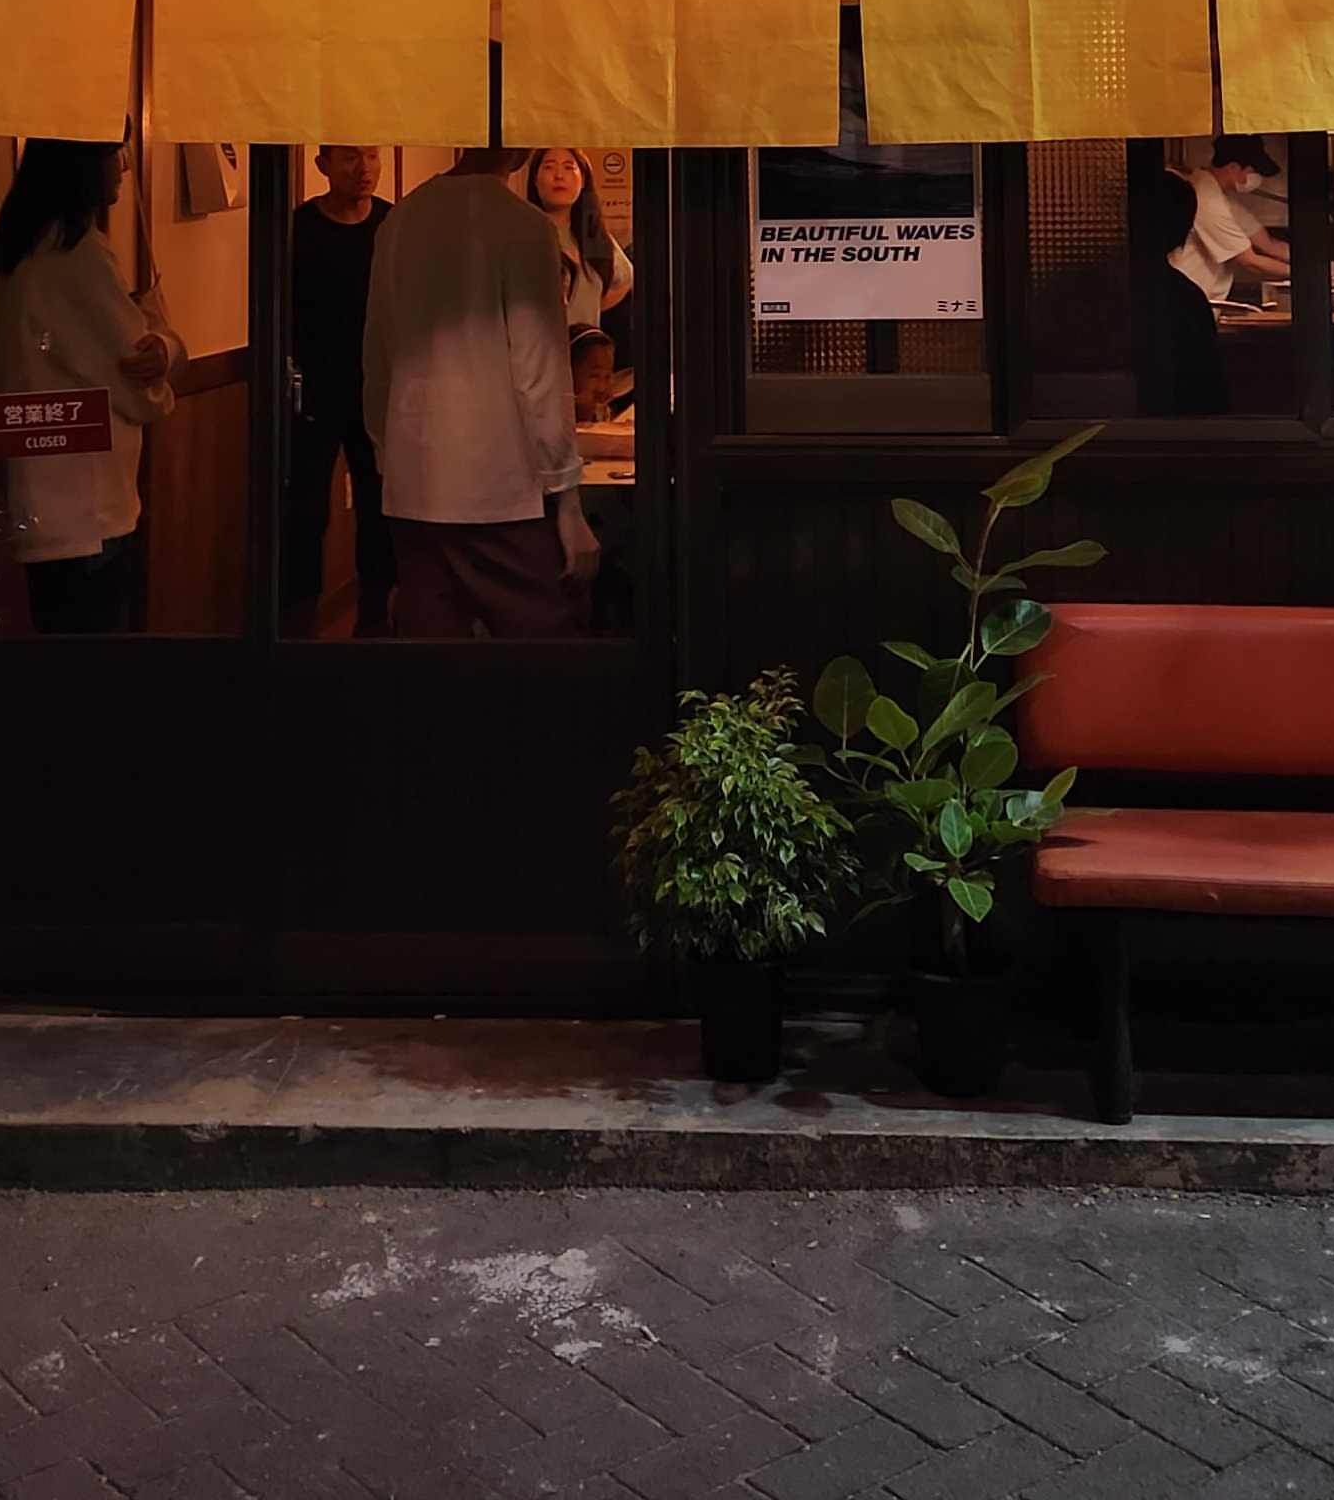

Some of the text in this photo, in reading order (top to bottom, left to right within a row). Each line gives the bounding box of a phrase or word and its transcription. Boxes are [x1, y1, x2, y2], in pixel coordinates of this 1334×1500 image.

[760, 224, 976, 242] BEAUTIFUL WAVES
[760, 246, 920, 263] IN THE SOUTH
[937, 300, 978, 312] ミナミ
[3, 401, 83, 425] 営業終了
[25, 435, 67, 449] CLOSED
